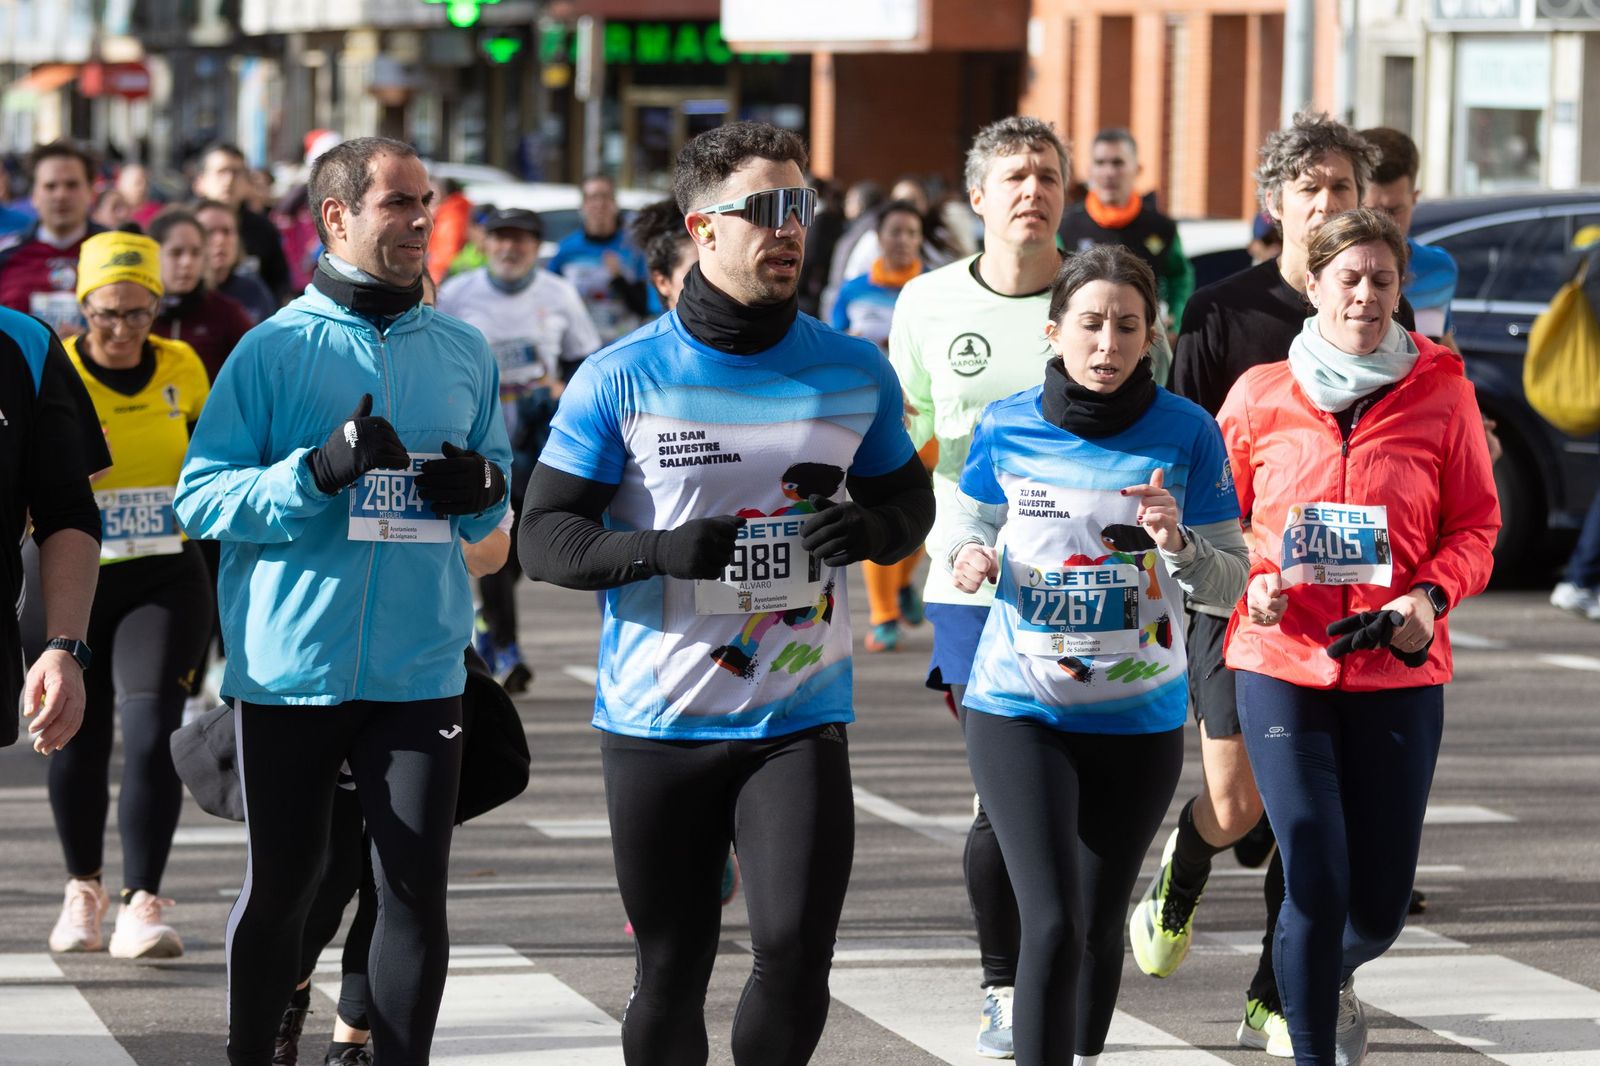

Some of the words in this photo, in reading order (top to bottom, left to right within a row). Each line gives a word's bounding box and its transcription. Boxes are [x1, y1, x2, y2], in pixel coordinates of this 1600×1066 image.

[950, 359, 988, 367] MAPOMA
[657, 432, 677, 443] XLI
[680, 430, 706, 441] SAN
[658, 442, 721, 456] SILVESTRE
[659, 453, 742, 468] SALMANTINA
[361, 475, 424, 512] 2984
[1018, 499, 1056, 508] SILVESTRE
[1018, 508, 1071, 518] SALMANTINA
[1304, 508, 1375, 524] SETEL
[105, 506, 164, 537] 5485
[736, 521, 804, 539] SETE
[1290, 526, 1362, 559] 3405
[739, 580, 772, 589] ALVARO
[1045, 570, 1126, 586] SETEL
[754, 595, 788, 603] Ayuntamiento
[1030, 589, 1107, 625] 2267
[1060, 625, 1076, 633] PAT
